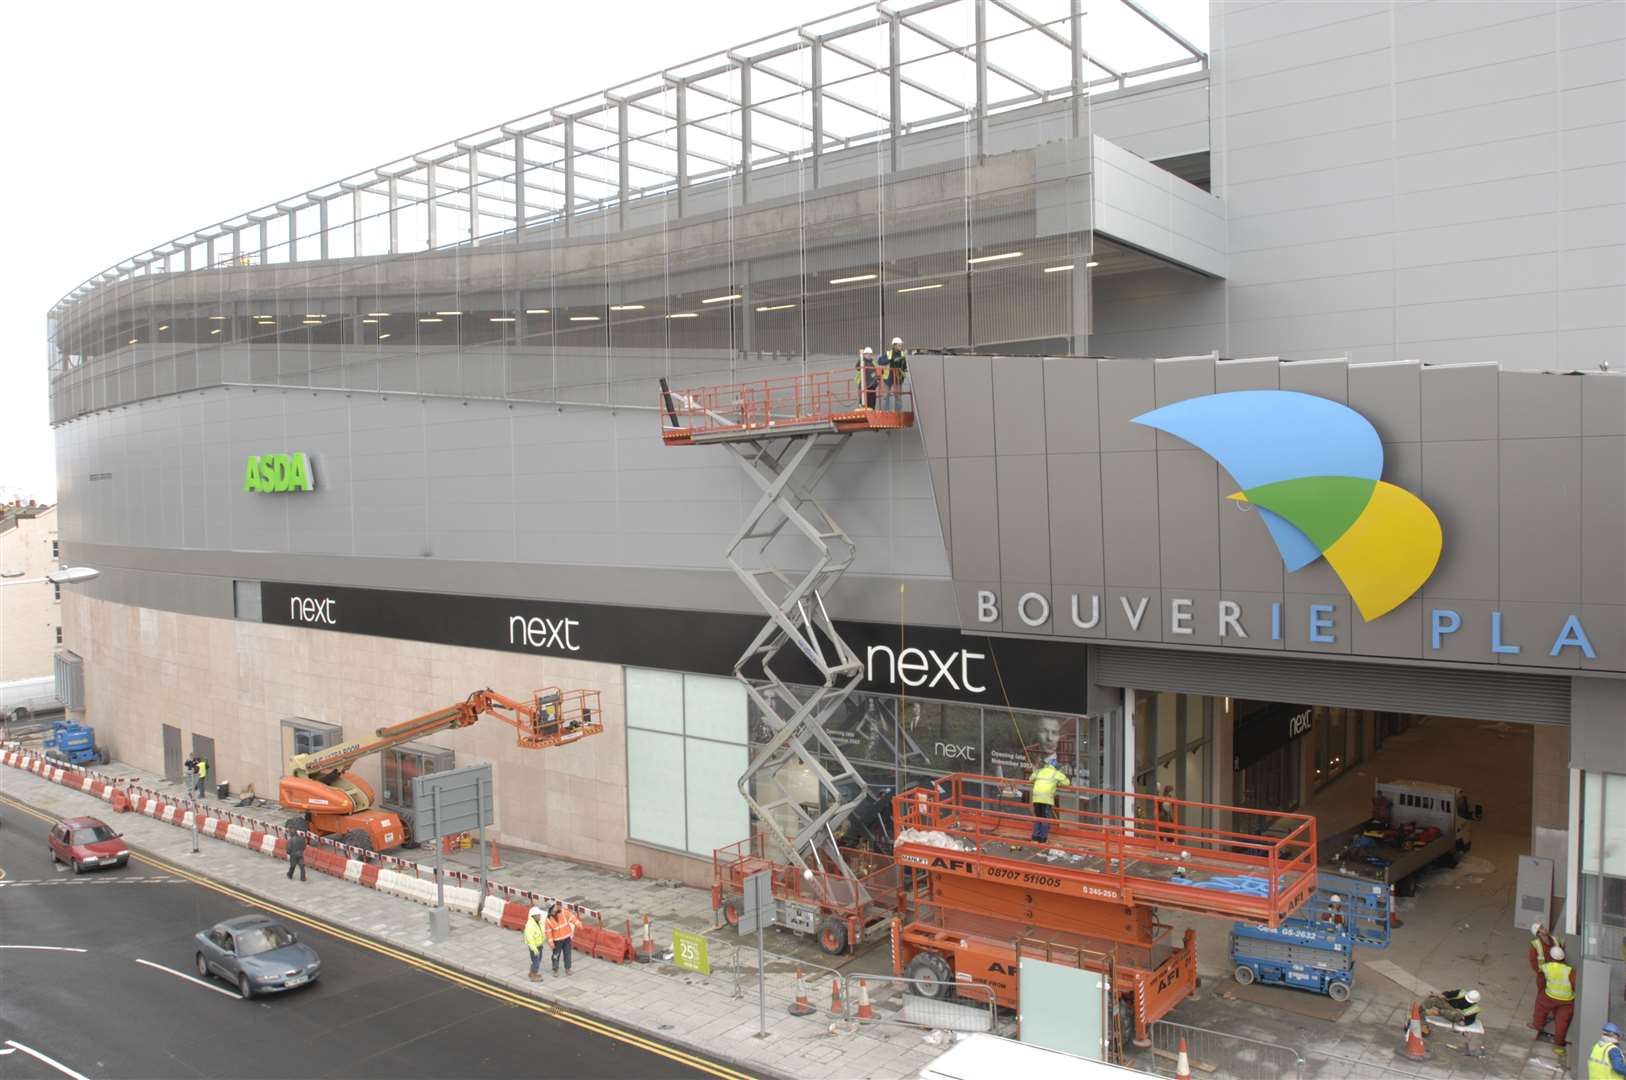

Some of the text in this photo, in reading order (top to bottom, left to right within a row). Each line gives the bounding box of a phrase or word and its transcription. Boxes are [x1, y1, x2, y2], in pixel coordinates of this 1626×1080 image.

[244, 451, 313, 493] ASDA
[290, 596, 337, 624] next
[977, 590, 1597, 659] BOUVERIE PLA
[509, 615, 580, 651] next
[866, 644, 986, 693] next
[1289, 709, 1312, 738] next
[934, 742, 976, 761] next
[931, 857, 973, 873] AFI
[987, 866, 1061, 888] 08707 511005
